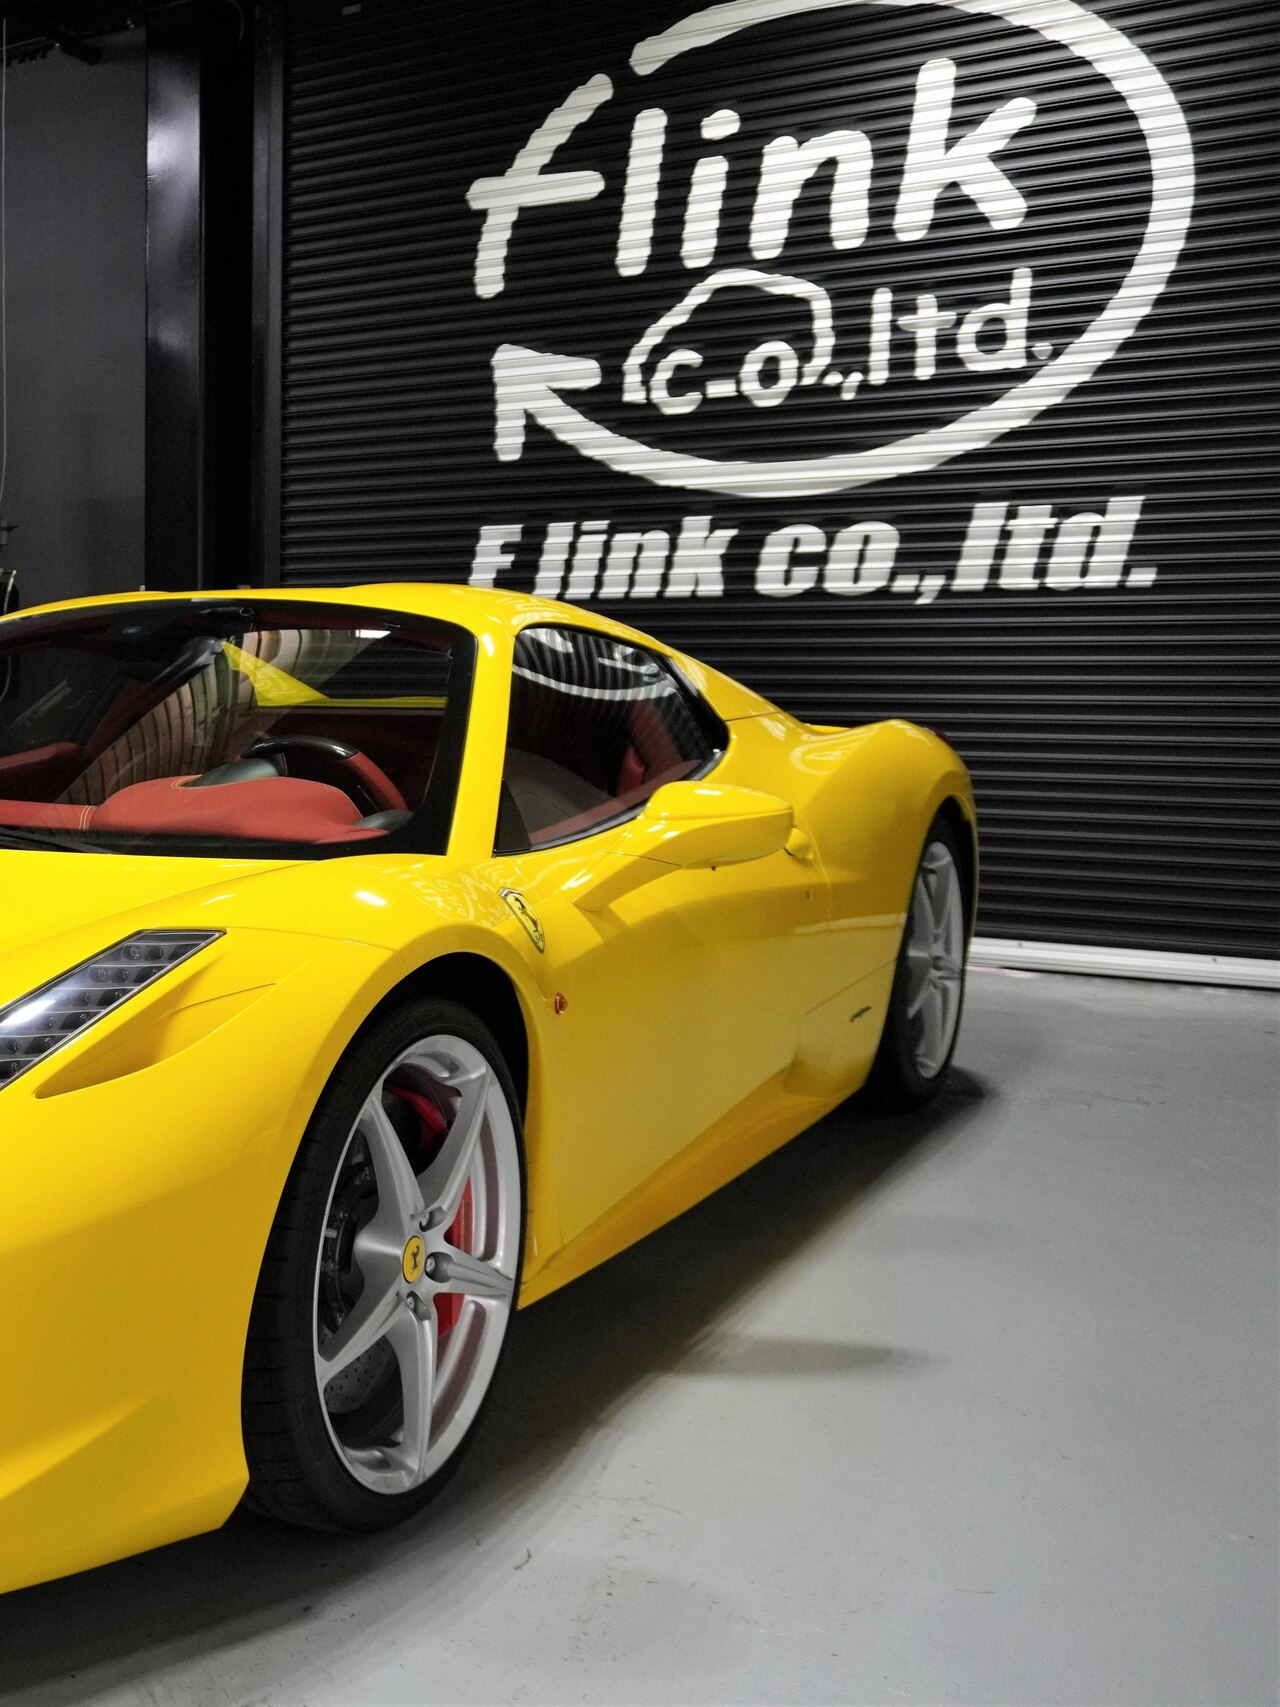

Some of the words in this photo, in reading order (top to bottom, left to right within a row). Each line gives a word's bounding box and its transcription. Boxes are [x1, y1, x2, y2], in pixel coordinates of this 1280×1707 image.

[467, 57, 1037, 298] flink
[533, 516, 738, 600] link
[754, 496, 1157, 604] co.,ltd.
